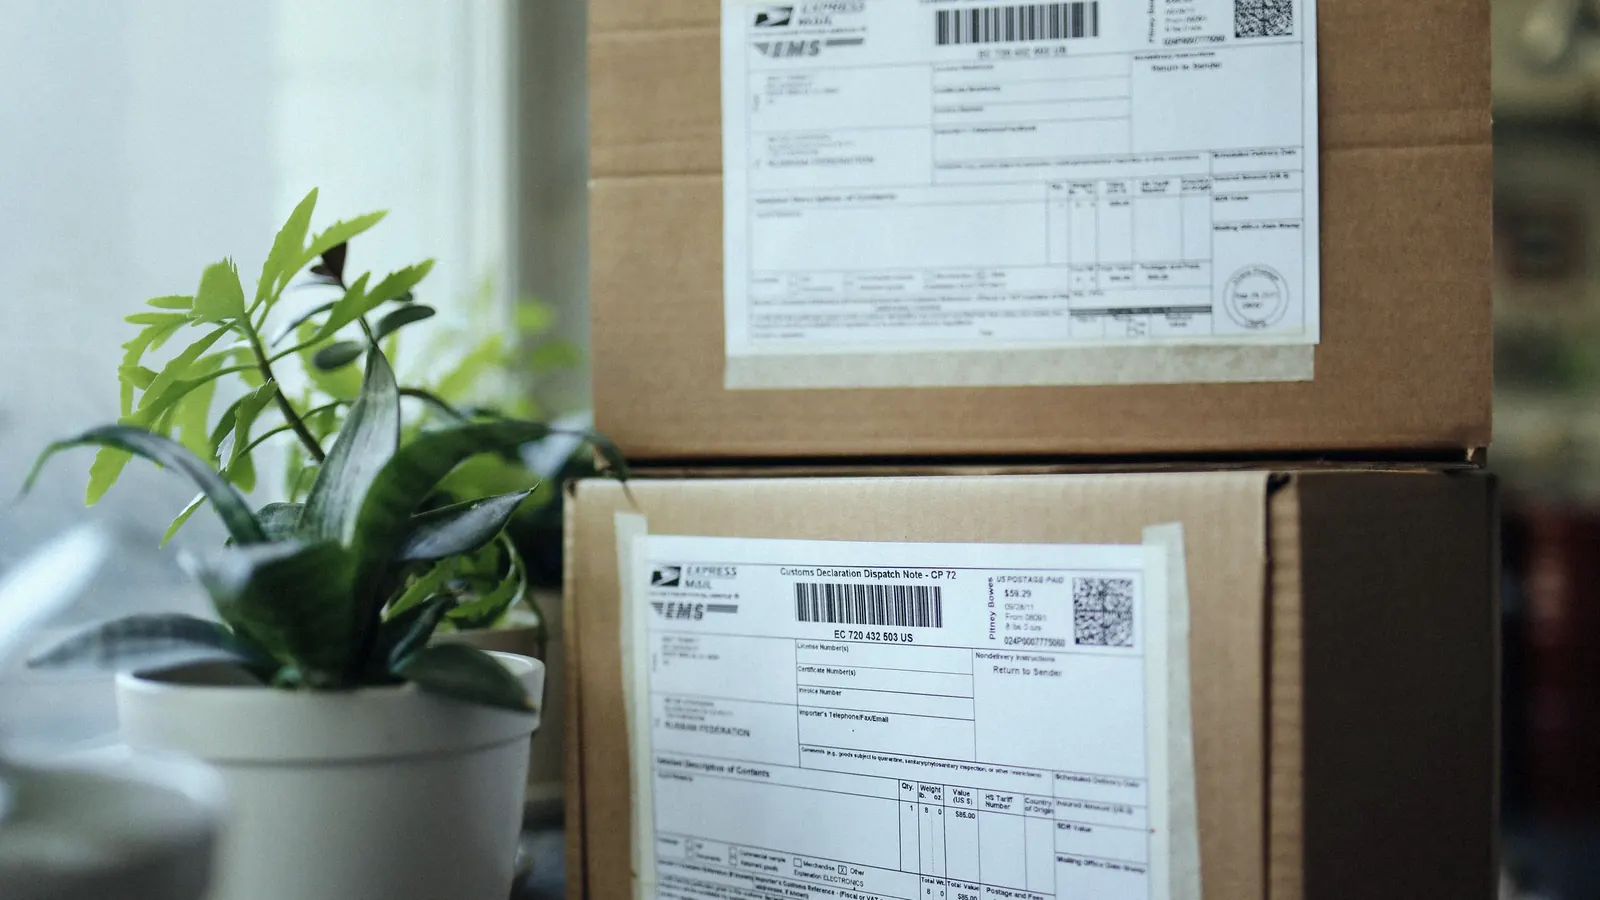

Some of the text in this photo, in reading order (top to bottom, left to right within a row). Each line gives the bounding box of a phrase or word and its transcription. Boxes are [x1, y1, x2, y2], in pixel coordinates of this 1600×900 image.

[780, 567, 814, 577] Customs
[816, 568, 862, 578] Declaration
[864, 569, 901, 580] Dispatch
[903, 570, 923, 579] Note
[931, 571, 944, 579] CP
[946, 571, 957, 580] 72
[667, 602, 704, 621] EMS
[988, 577, 997, 640] Pitney Bowes
[834, 630, 914, 643] EC 720 432 503 US
[797, 643, 849, 653] License Number(s)
[975, 652, 1014, 662] Nondelivery
[797, 666, 856, 677] Certificate Number(s)
[993, 665, 1062, 678] Return to Sender
[798, 687, 842, 697] Invoice Number
[799, 709, 889, 723] Importer's Telephone/Fax/Email
[839, 751, 853, 759] goods
[854, 752, 871, 761] subject
[901, 782, 914, 791] Qty.
[919, 784, 942, 794] Weight
[952, 788, 971, 797] Value
[952, 797, 973, 806] (US $)
[985, 793, 1013, 803] HS Tariff
[1024, 797, 1053, 809] Country
[985, 801, 1012, 810] Number
[1024, 804, 1055, 816] of Origin
[955, 810, 976, 820] $85.00
[850, 867, 866, 877] Other
[793, 868, 864, 888] Explanation ELECTRONICS
[921, 876, 935, 884] Total
[783, 880, 807, 890] Customs
[807, 883, 835, 895] Reference
[839, 890, 858, 900] (Fiscal
[947, 880, 979, 891] Total Value
[986, 886, 1013, 898] Postage
[1014, 890, 1026, 899] and
